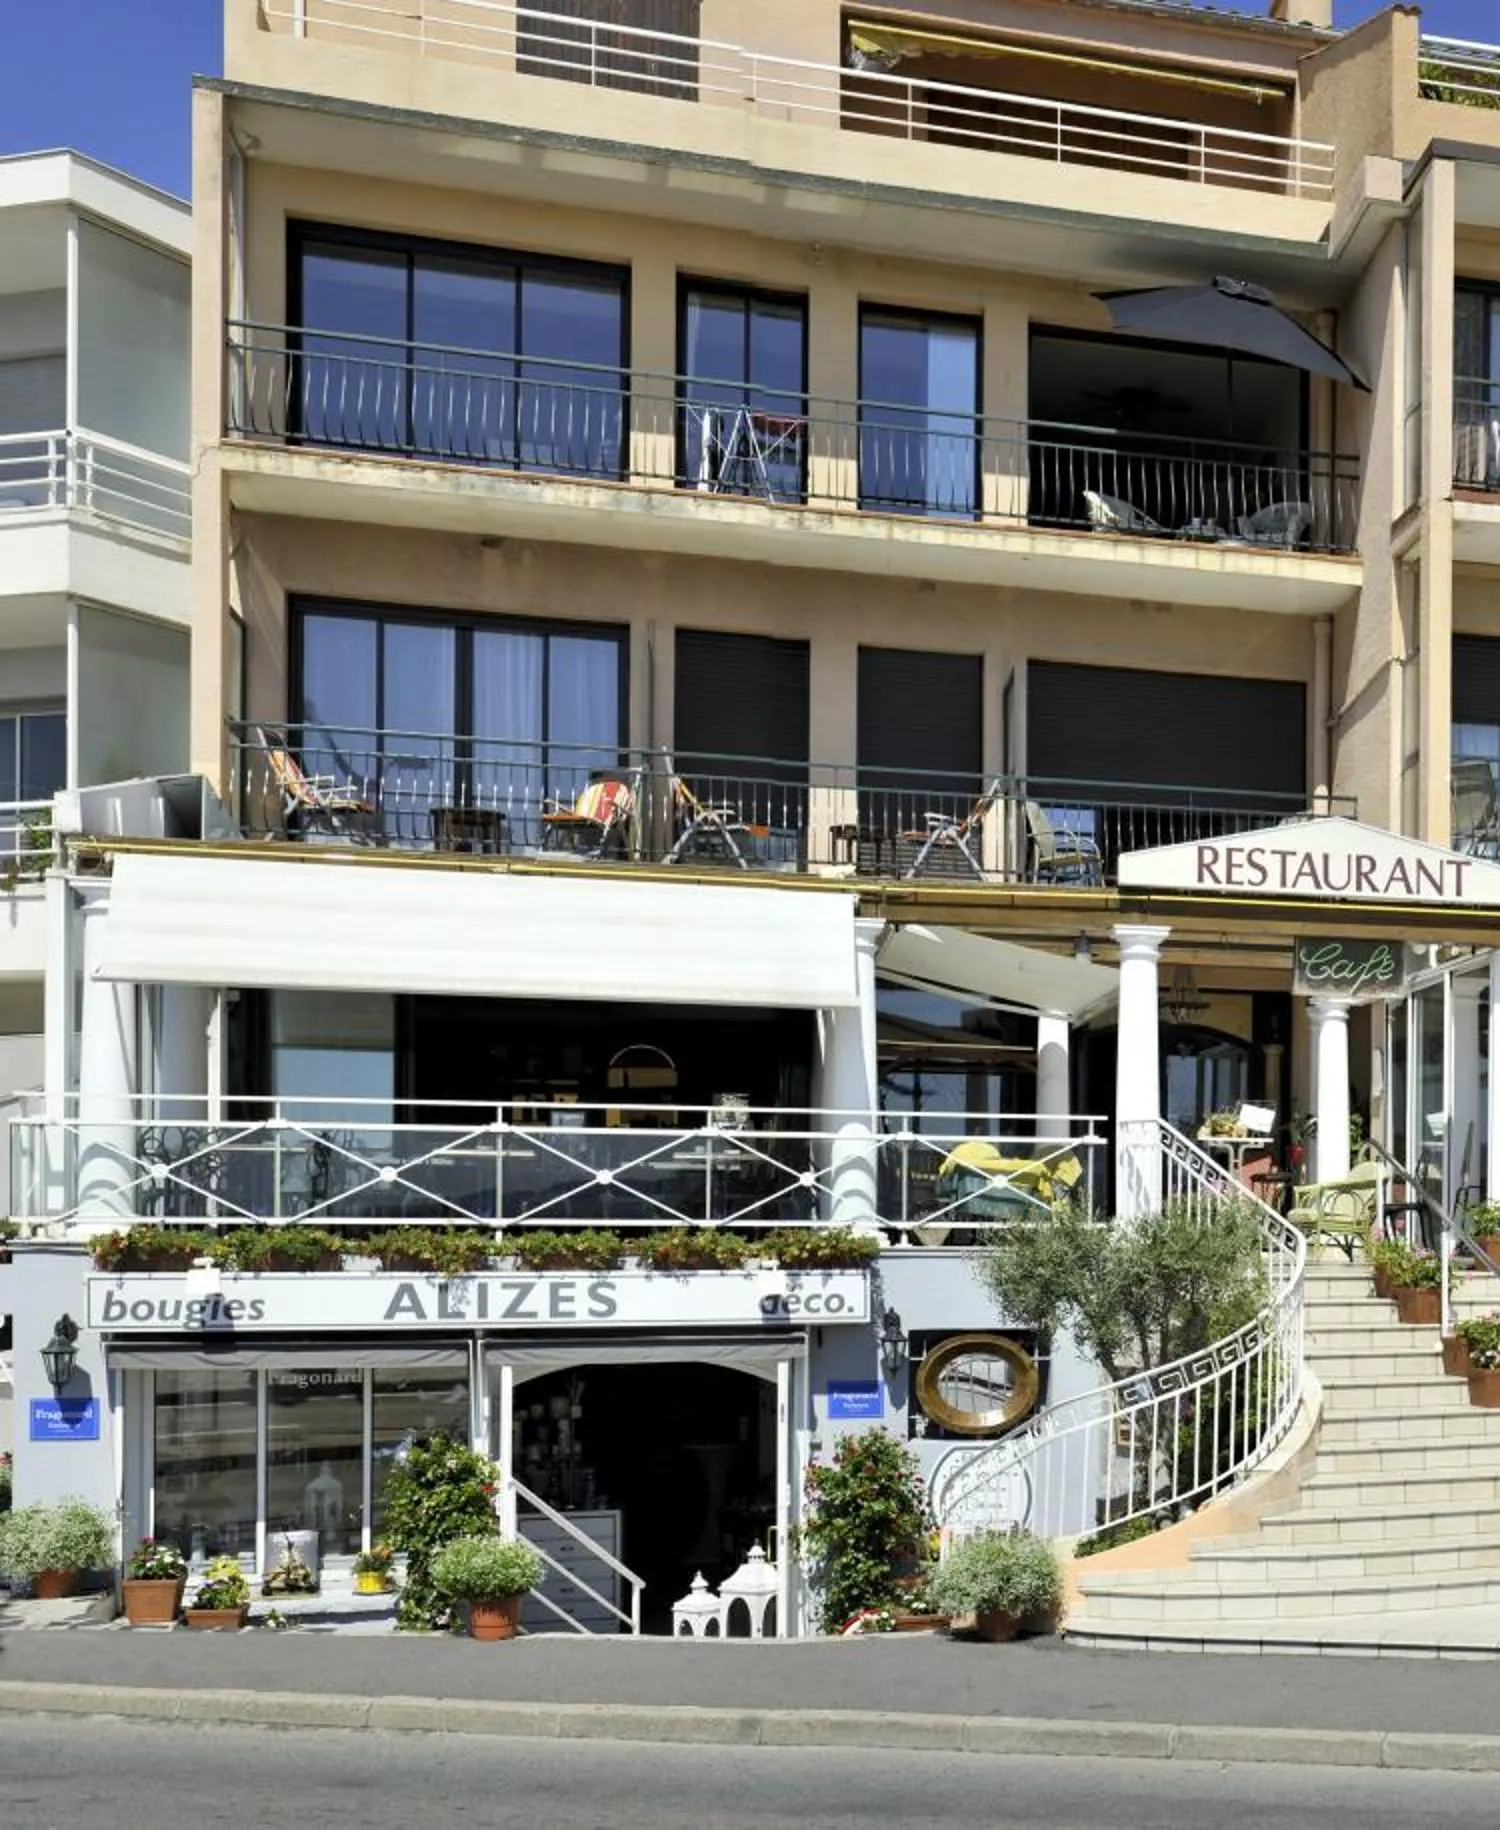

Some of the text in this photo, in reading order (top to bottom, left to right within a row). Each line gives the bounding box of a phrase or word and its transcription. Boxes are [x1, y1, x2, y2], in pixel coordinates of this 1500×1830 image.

[1196, 845, 1472, 898] RESTAURANT
[1300, 943, 1396, 996] Café
[102, 1289, 266, 1331] bougies
